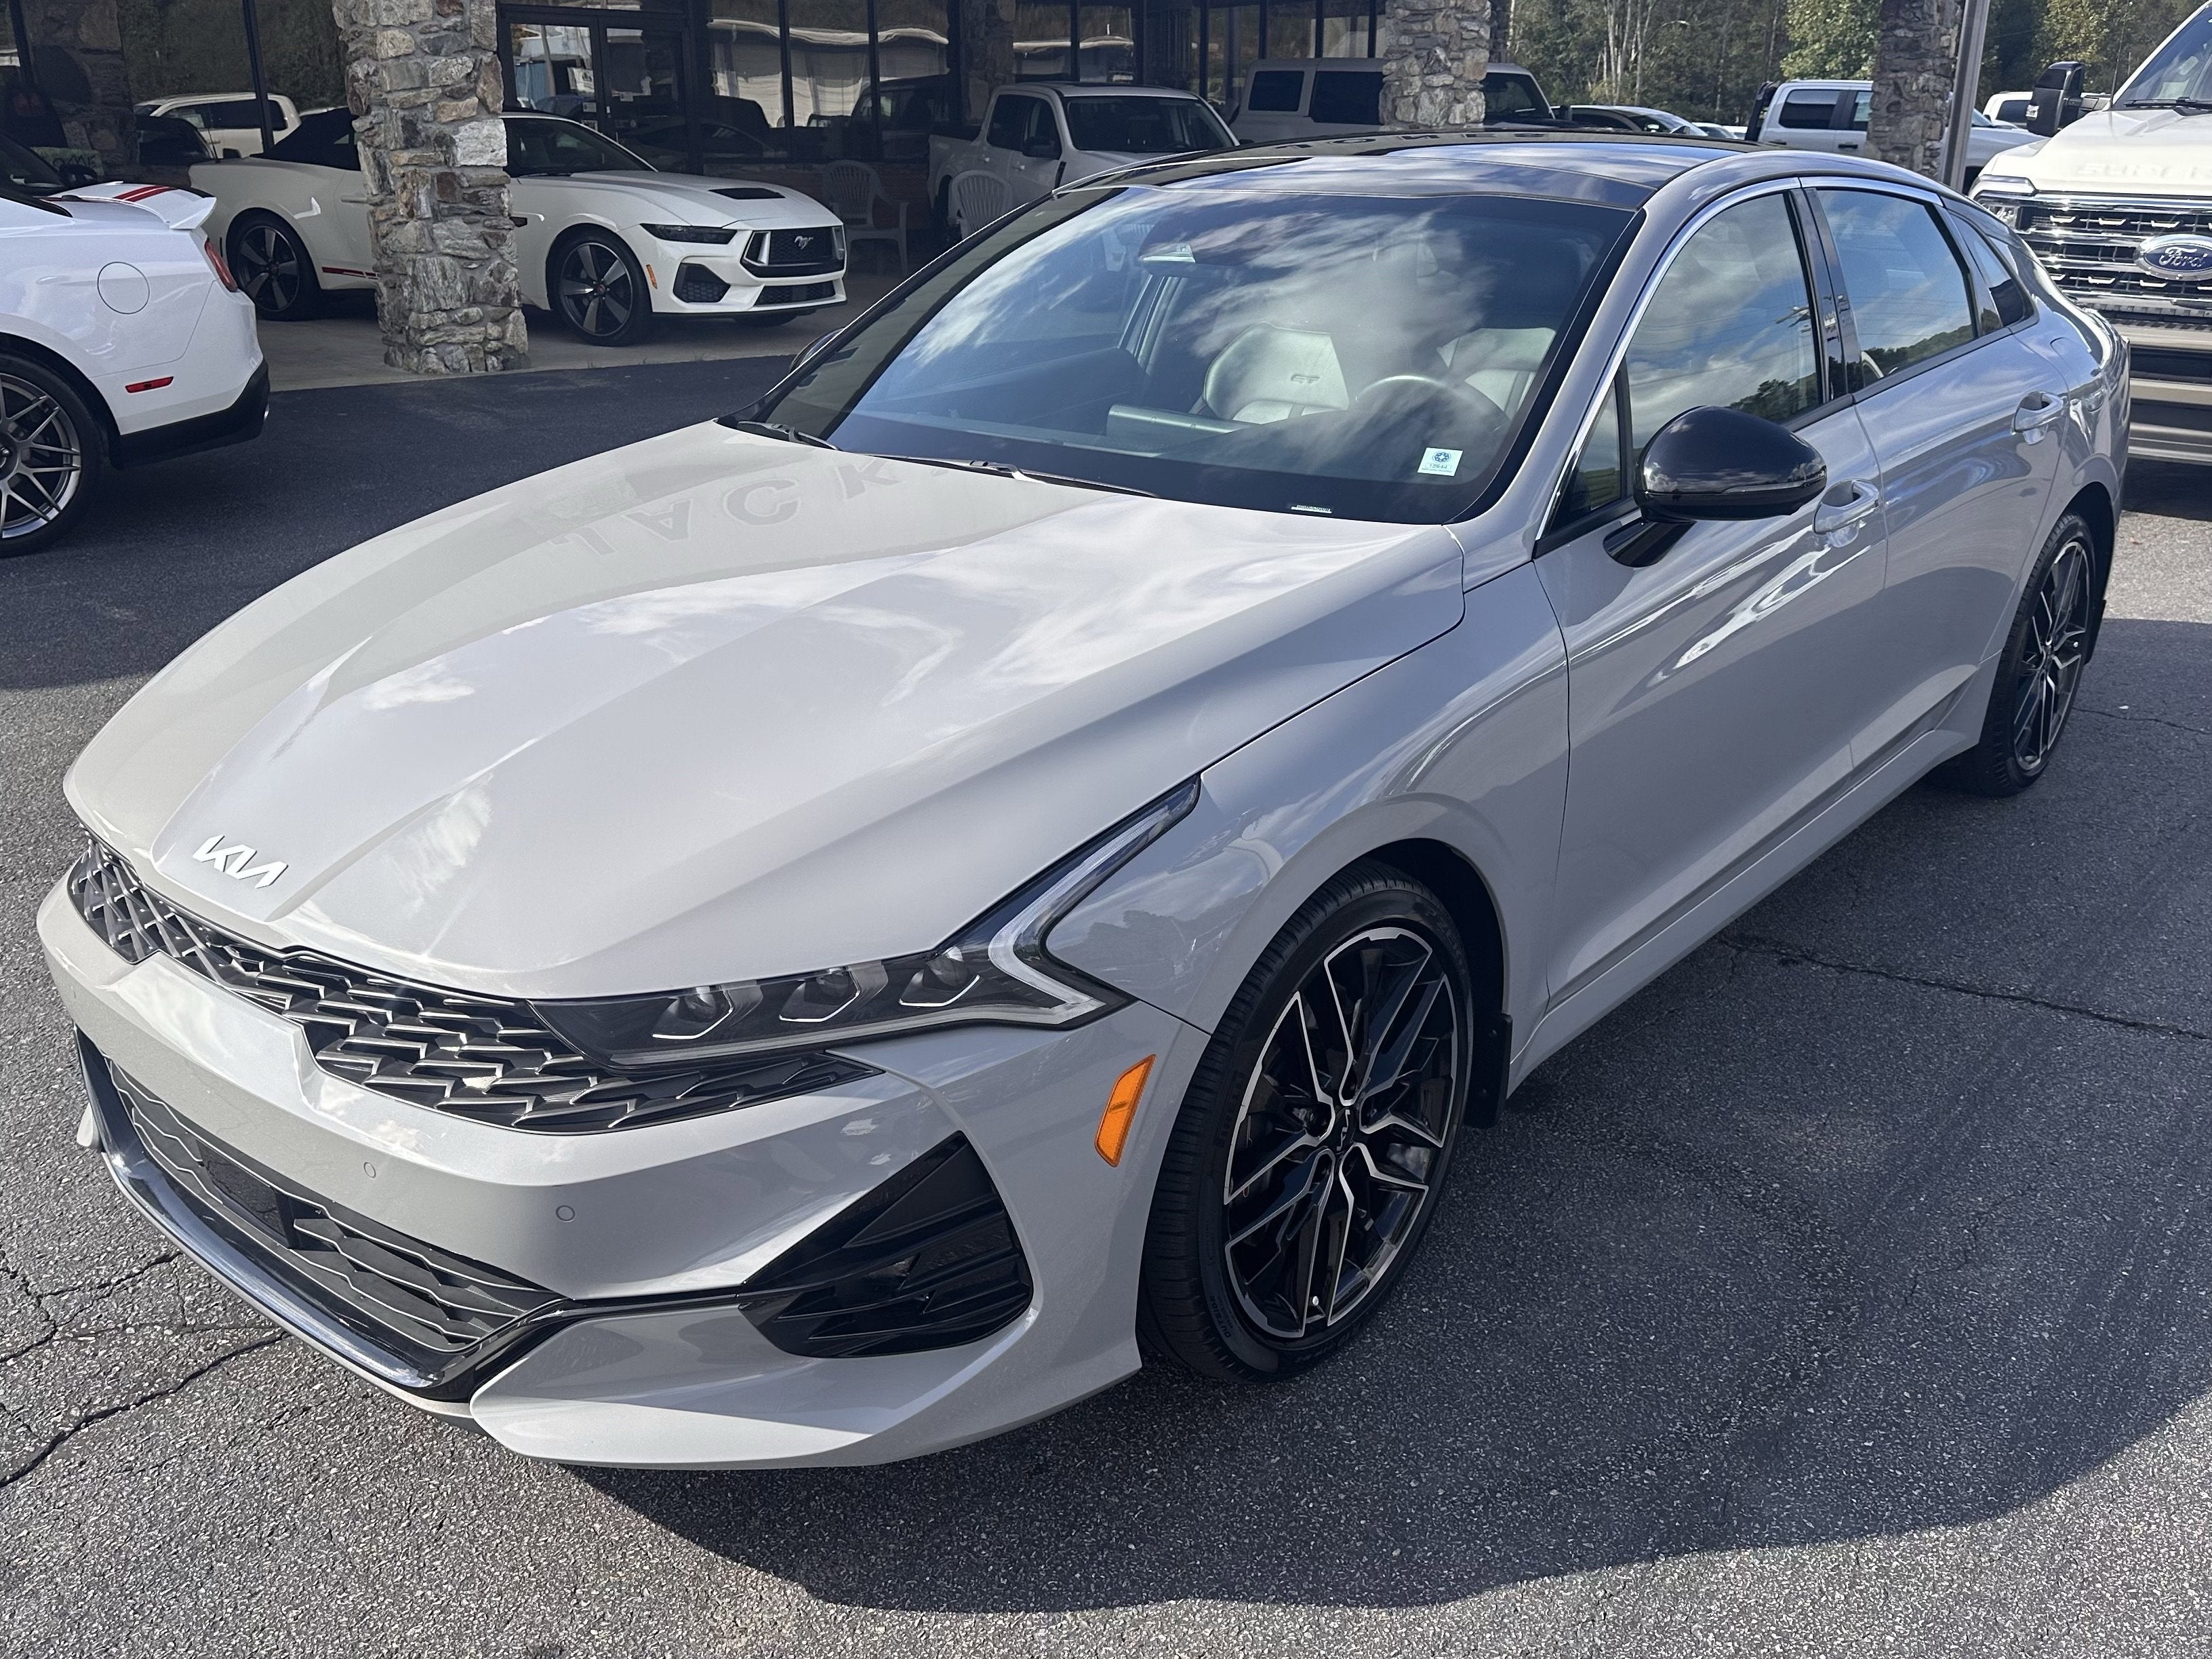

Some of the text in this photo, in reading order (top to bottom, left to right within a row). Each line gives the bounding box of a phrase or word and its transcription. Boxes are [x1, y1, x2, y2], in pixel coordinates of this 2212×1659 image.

[2159, 246, 2208, 268] Ford
[192, 835, 289, 889] KIA
[1209, 1295, 1231, 1338] OUTSIDE
